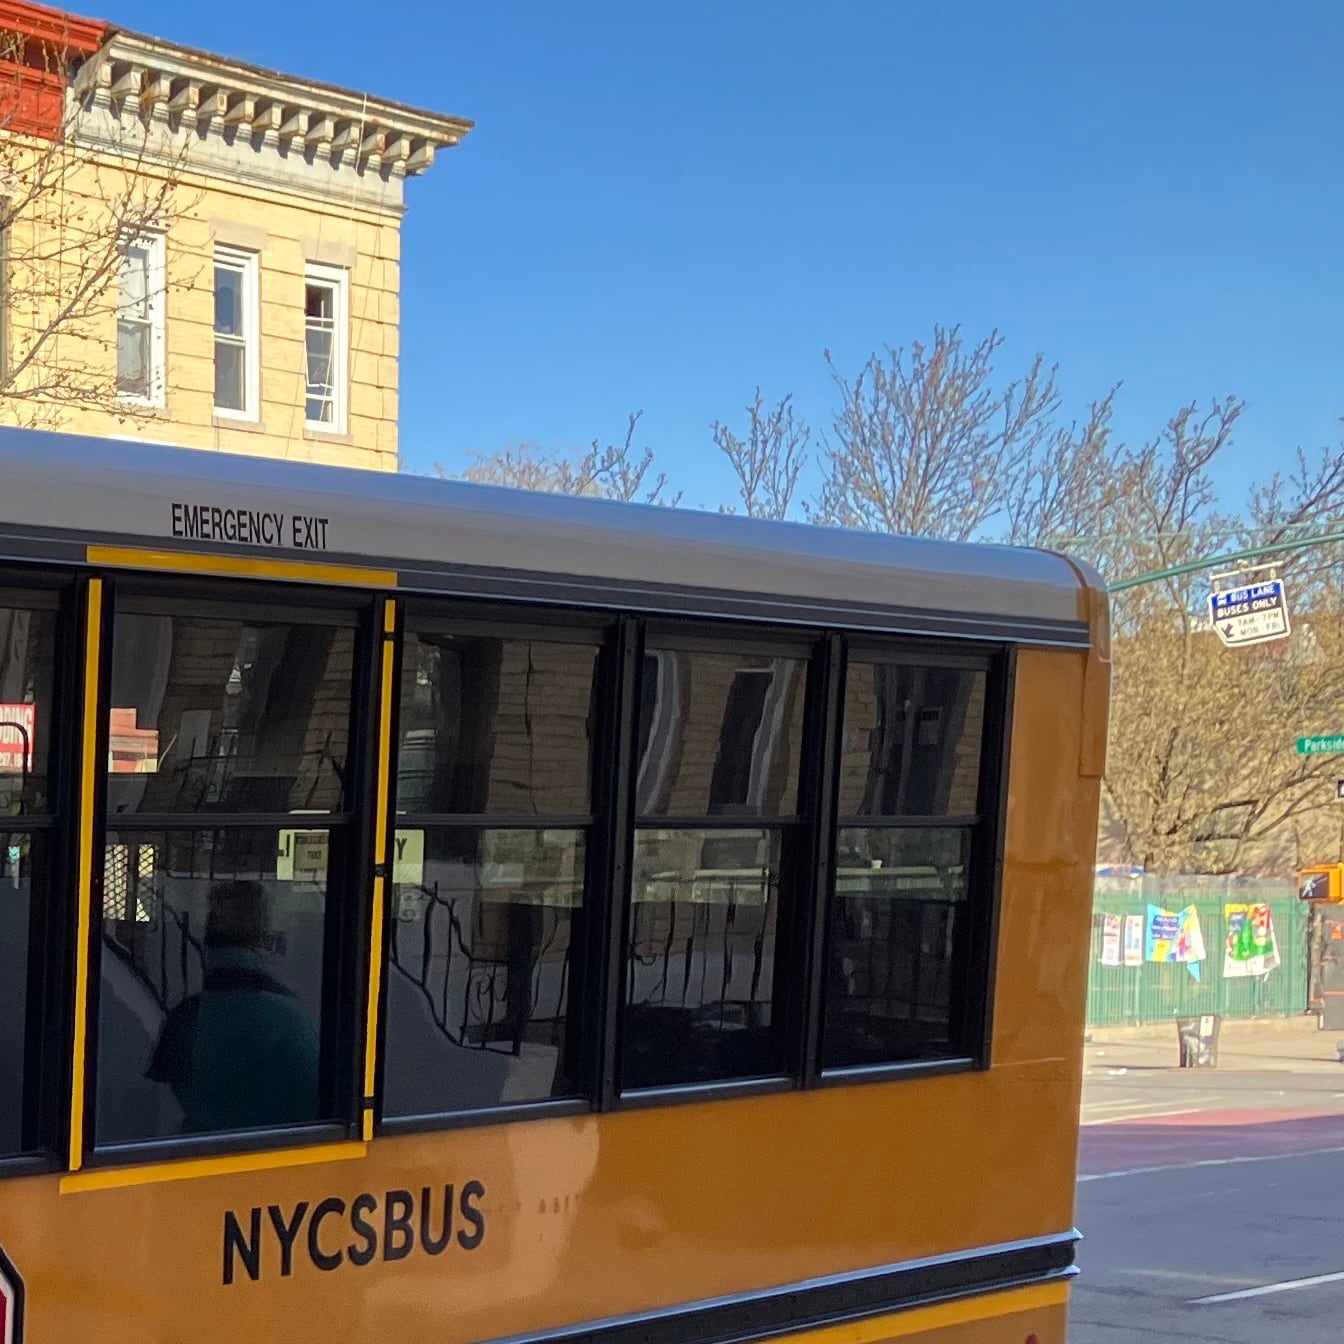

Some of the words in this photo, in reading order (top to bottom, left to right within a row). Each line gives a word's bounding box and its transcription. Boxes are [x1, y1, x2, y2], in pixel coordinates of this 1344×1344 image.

[171, 503, 284, 546] EMERGENCY
[292, 516, 329, 550] EXIT
[1217, 602, 1249, 617] BUSES
[1253, 597, 1278, 610] ONLY
[1231, 590, 1248, 602] BUS
[1252, 585, 1275, 597] LANE
[222, 1180, 485, 1285] NYCSBUS
